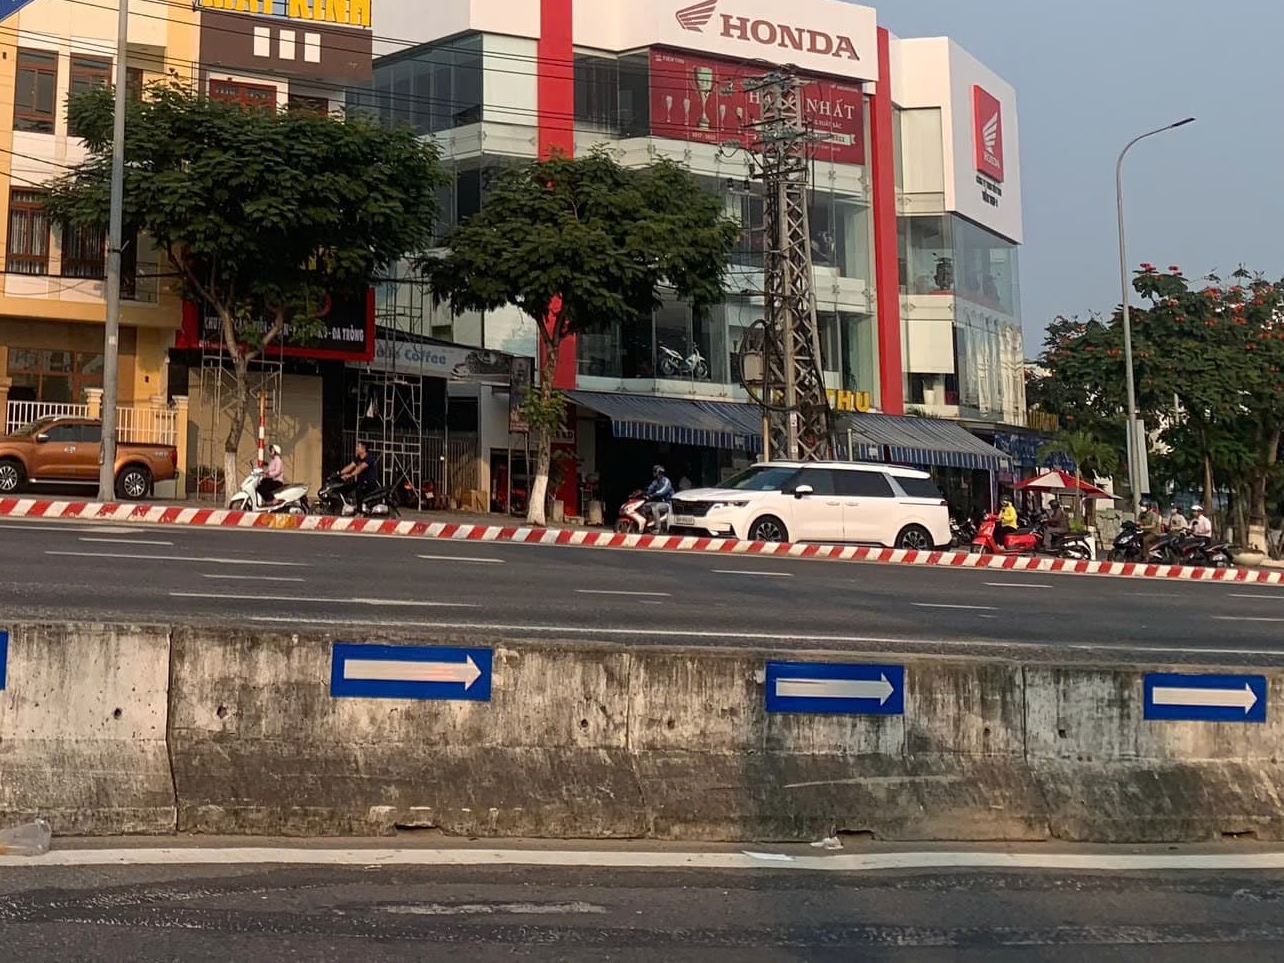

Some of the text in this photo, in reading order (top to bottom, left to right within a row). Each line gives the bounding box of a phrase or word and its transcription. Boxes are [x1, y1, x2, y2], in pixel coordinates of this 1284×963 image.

[720, 13, 860, 61] HONDA
[806, 98, 855, 120] NHẤT
[404, 349, 446, 365] Coffee
